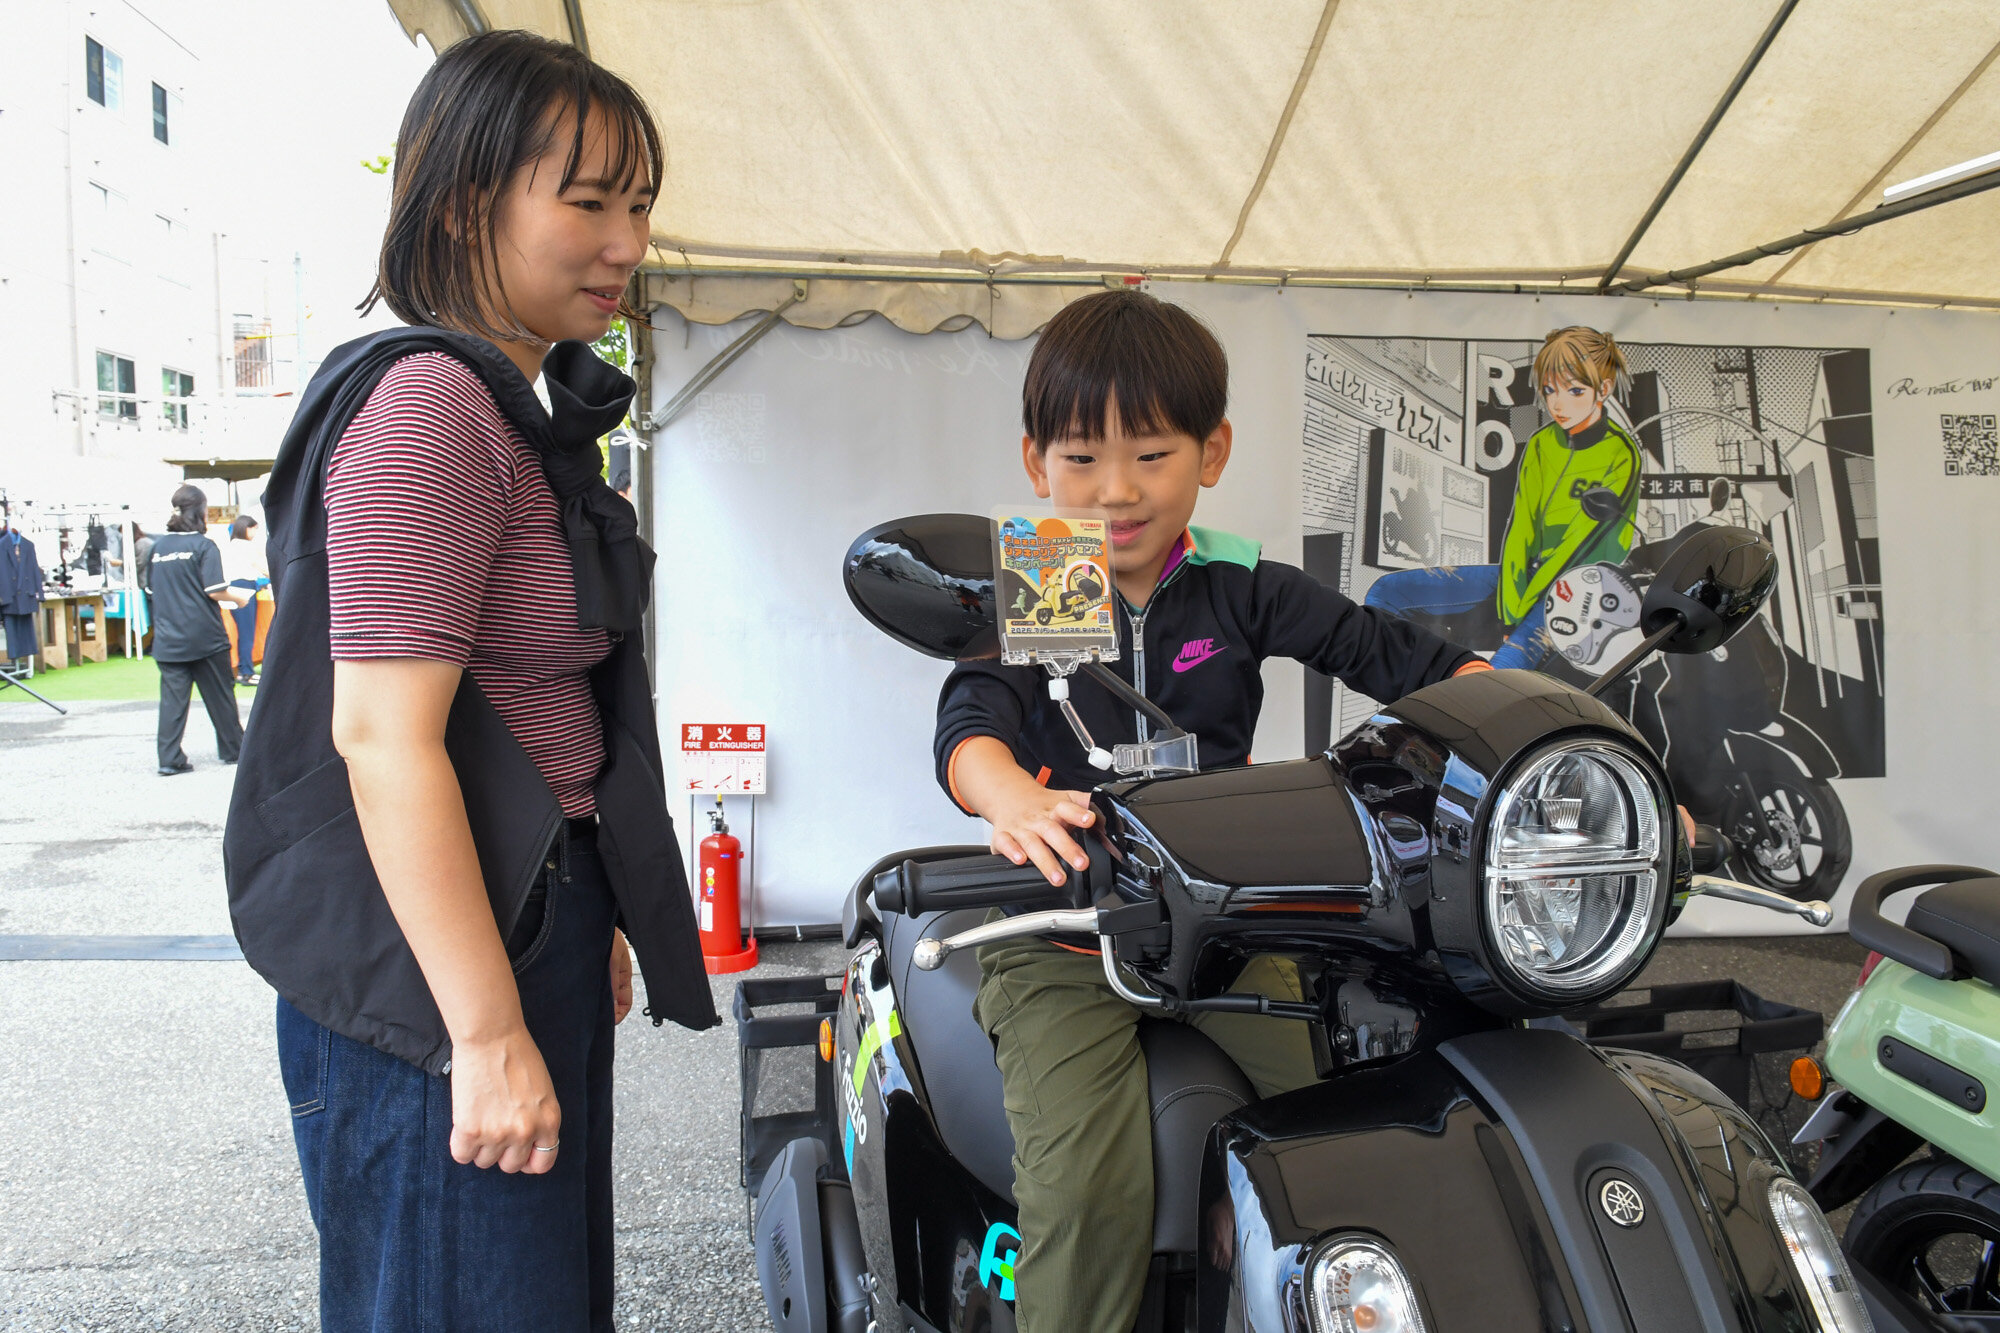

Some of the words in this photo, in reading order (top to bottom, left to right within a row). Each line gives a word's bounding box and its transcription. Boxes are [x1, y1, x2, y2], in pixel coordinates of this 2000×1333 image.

[1180, 638, 1214, 659] NIKE
[687, 726, 761, 741] 消火器
[684, 741, 701, 749] FIRE
[709, 741, 764, 749] EXTINGUISHER
